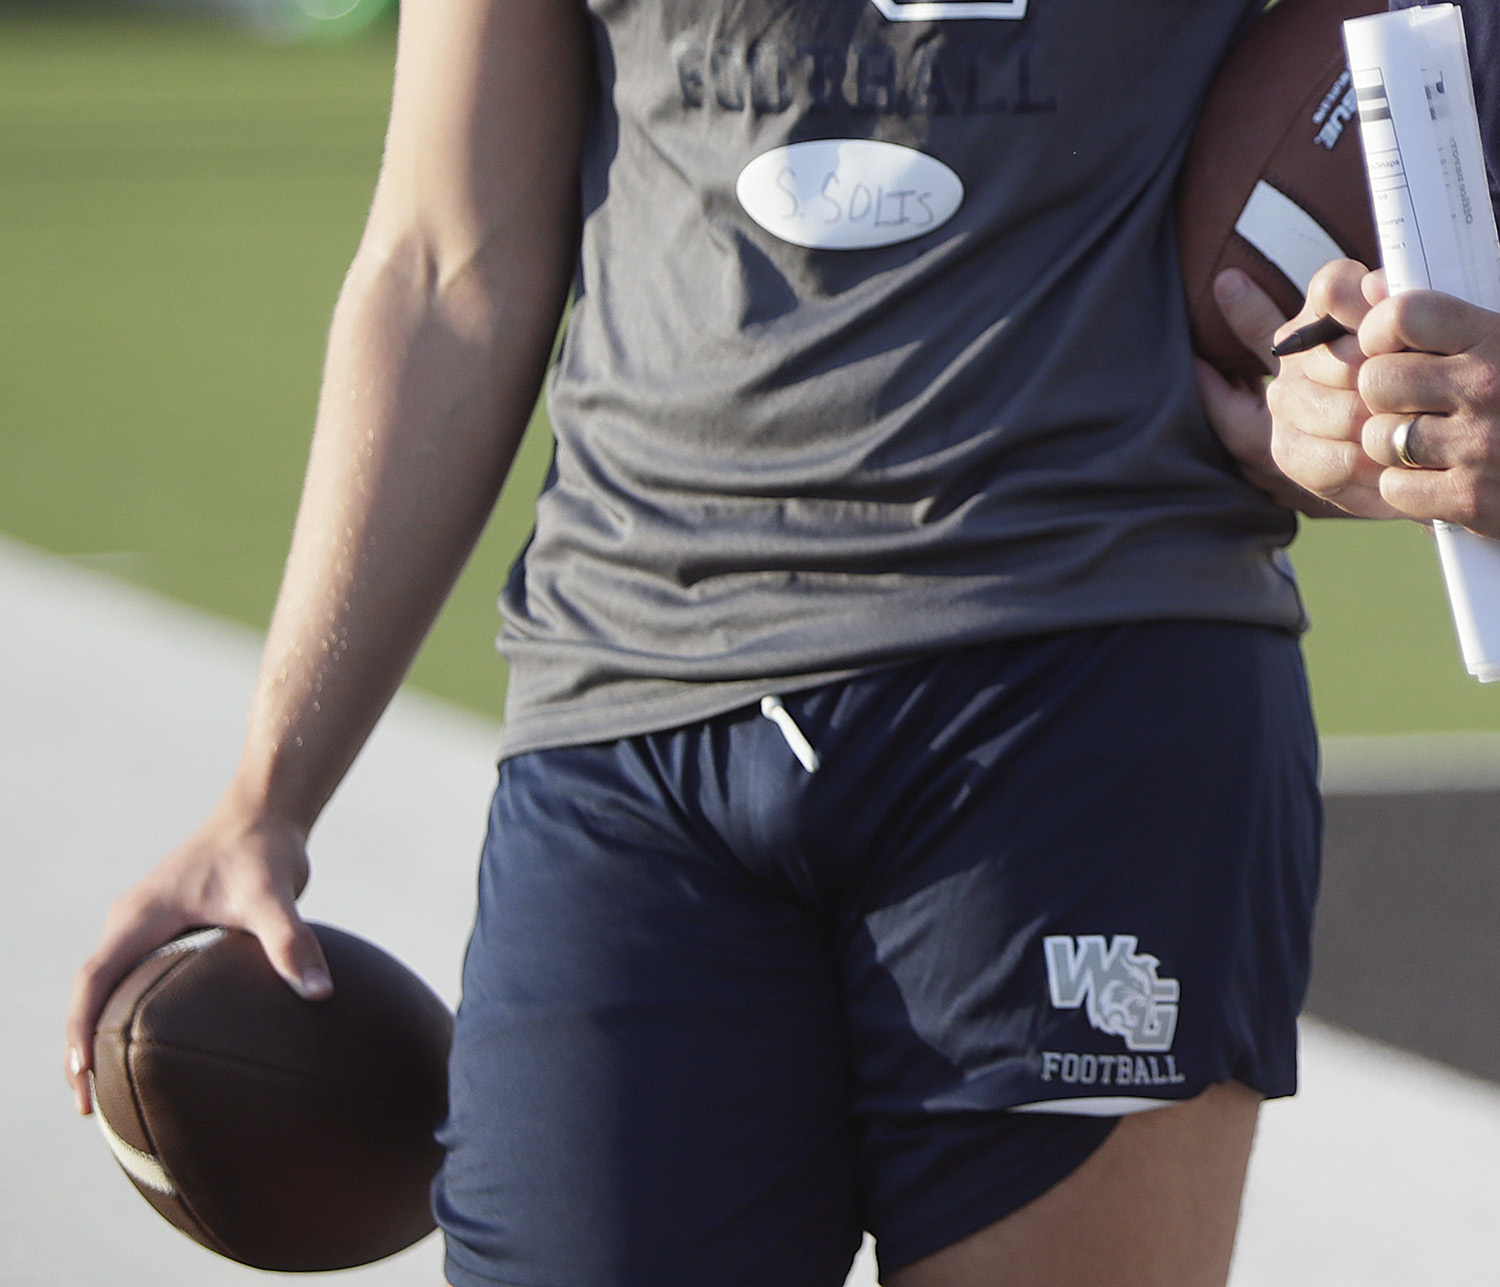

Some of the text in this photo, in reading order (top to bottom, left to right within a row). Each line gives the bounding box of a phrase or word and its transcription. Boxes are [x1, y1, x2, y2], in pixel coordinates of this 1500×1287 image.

[672, 38, 1058, 115] FOOTBALL
[821, 170, 935, 228] SOLIS
[1040, 1051, 1186, 1086] FOOTBALL
